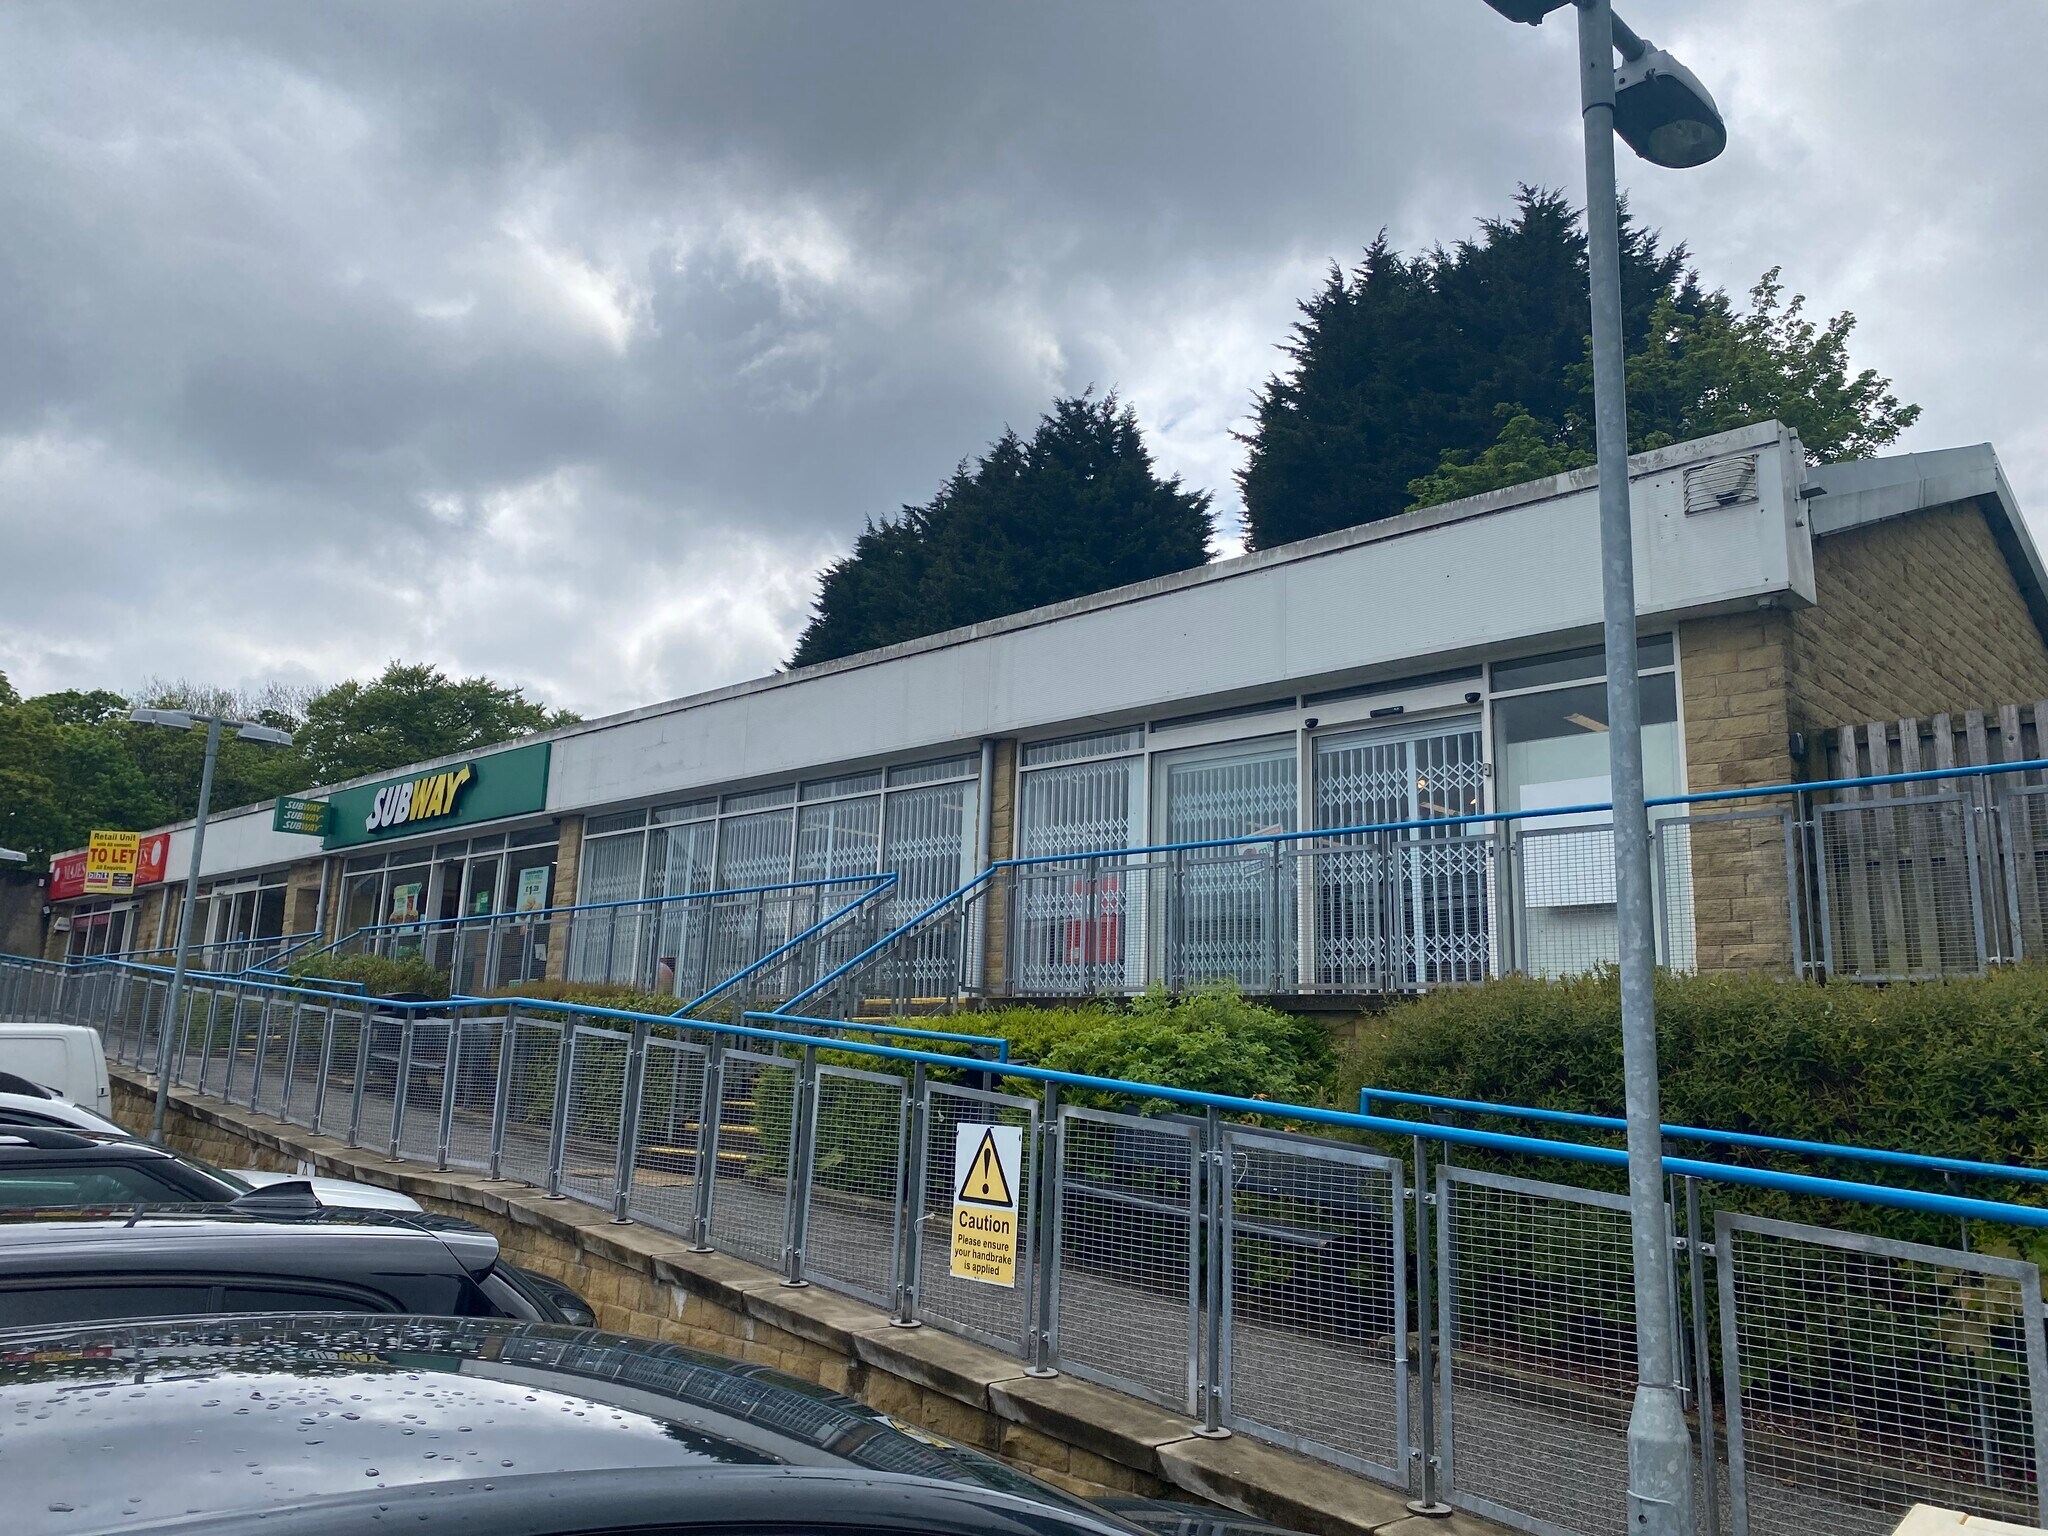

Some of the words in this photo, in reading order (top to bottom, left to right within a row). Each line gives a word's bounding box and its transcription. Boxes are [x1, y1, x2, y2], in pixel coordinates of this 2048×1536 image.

[365, 763, 471, 832] SUBWAY
[285, 801, 325, 812] SUBWAY
[283, 811, 324, 822] SUBWAY
[282, 820, 323, 832] SUBWAY
[90, 848, 108, 863] TO
[111, 848, 137, 864] LET
[959, 1210, 1010, 1235] Caution
[957, 1233, 982, 1247] Please
[982, 1240, 1009, 1252] ensure
[954, 1247, 971, 1258] your
[972, 1249, 1012, 1265] handbrake
[964, 1260, 971, 1270] is
[972, 1263, 1000, 1276] applied
